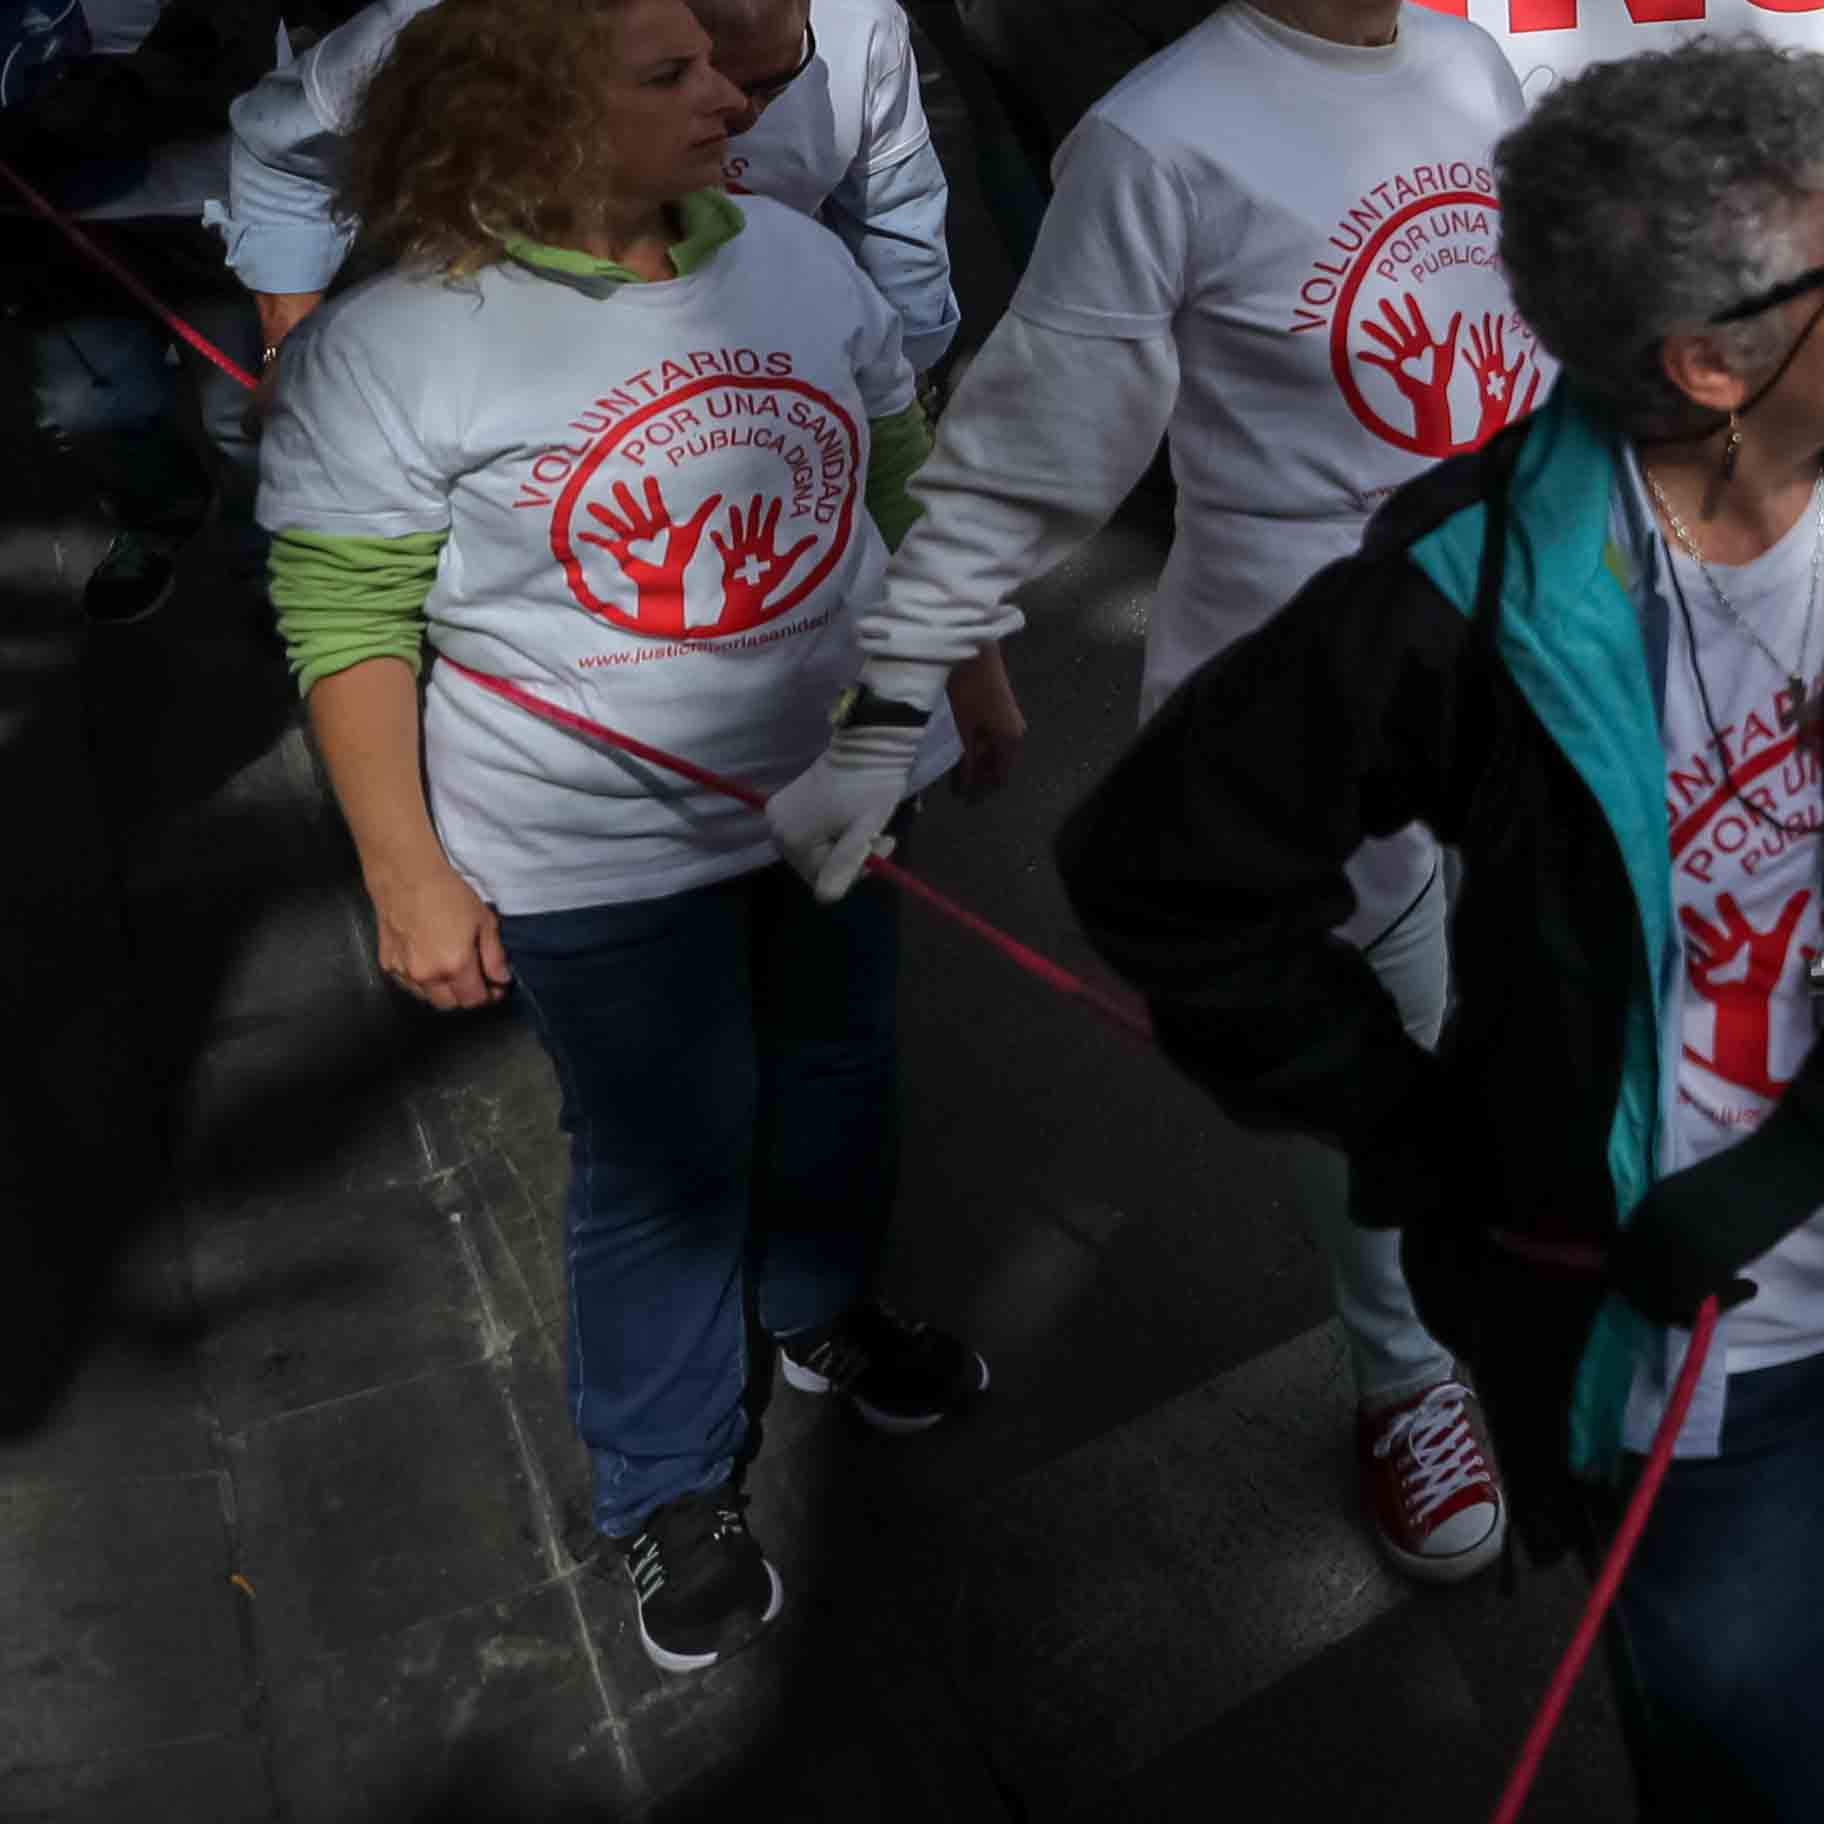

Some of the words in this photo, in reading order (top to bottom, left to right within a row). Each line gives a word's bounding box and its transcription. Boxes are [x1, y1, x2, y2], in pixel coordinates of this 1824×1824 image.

[1288, 161, 1493, 333] VOLUNTARIOS
[1376, 224, 1431, 283] POR
[1428, 209, 1489, 238] UNA
[511, 347, 794, 510] VOLUNTARIOS
[620, 408, 701, 466] POR
[705, 392, 781, 419] UNA
[786, 398, 847, 525] SANIDAD
[783, 445, 814, 519] DIGNA
